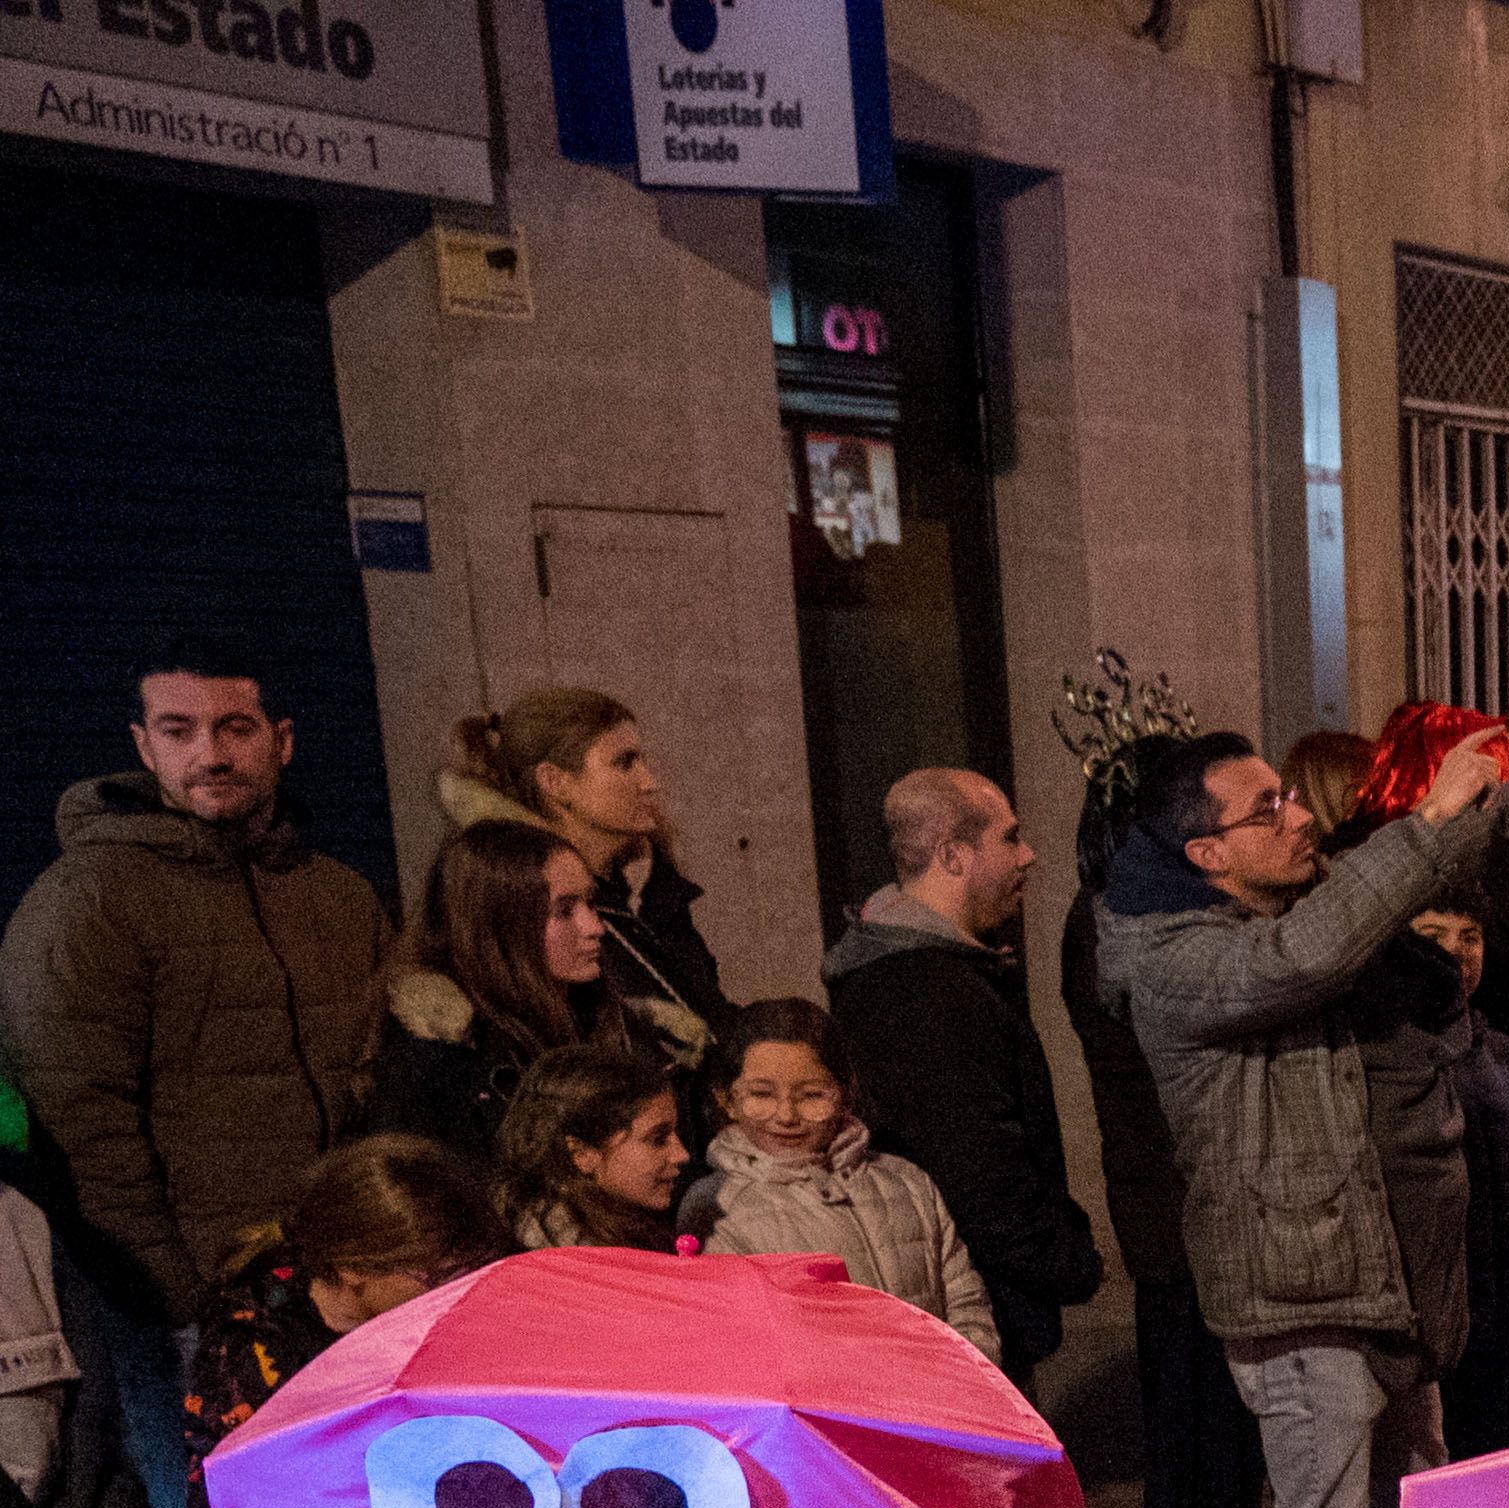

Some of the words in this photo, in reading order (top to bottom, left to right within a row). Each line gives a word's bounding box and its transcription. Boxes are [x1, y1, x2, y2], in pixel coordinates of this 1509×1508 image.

[752, 69, 767, 99] y
[36, 80, 307, 160] Administració
[363, 135, 381, 170] 1
[664, 100, 764, 132] Apuestas
[769, 100, 803, 129] del
[664, 135, 740, 162] Estado
